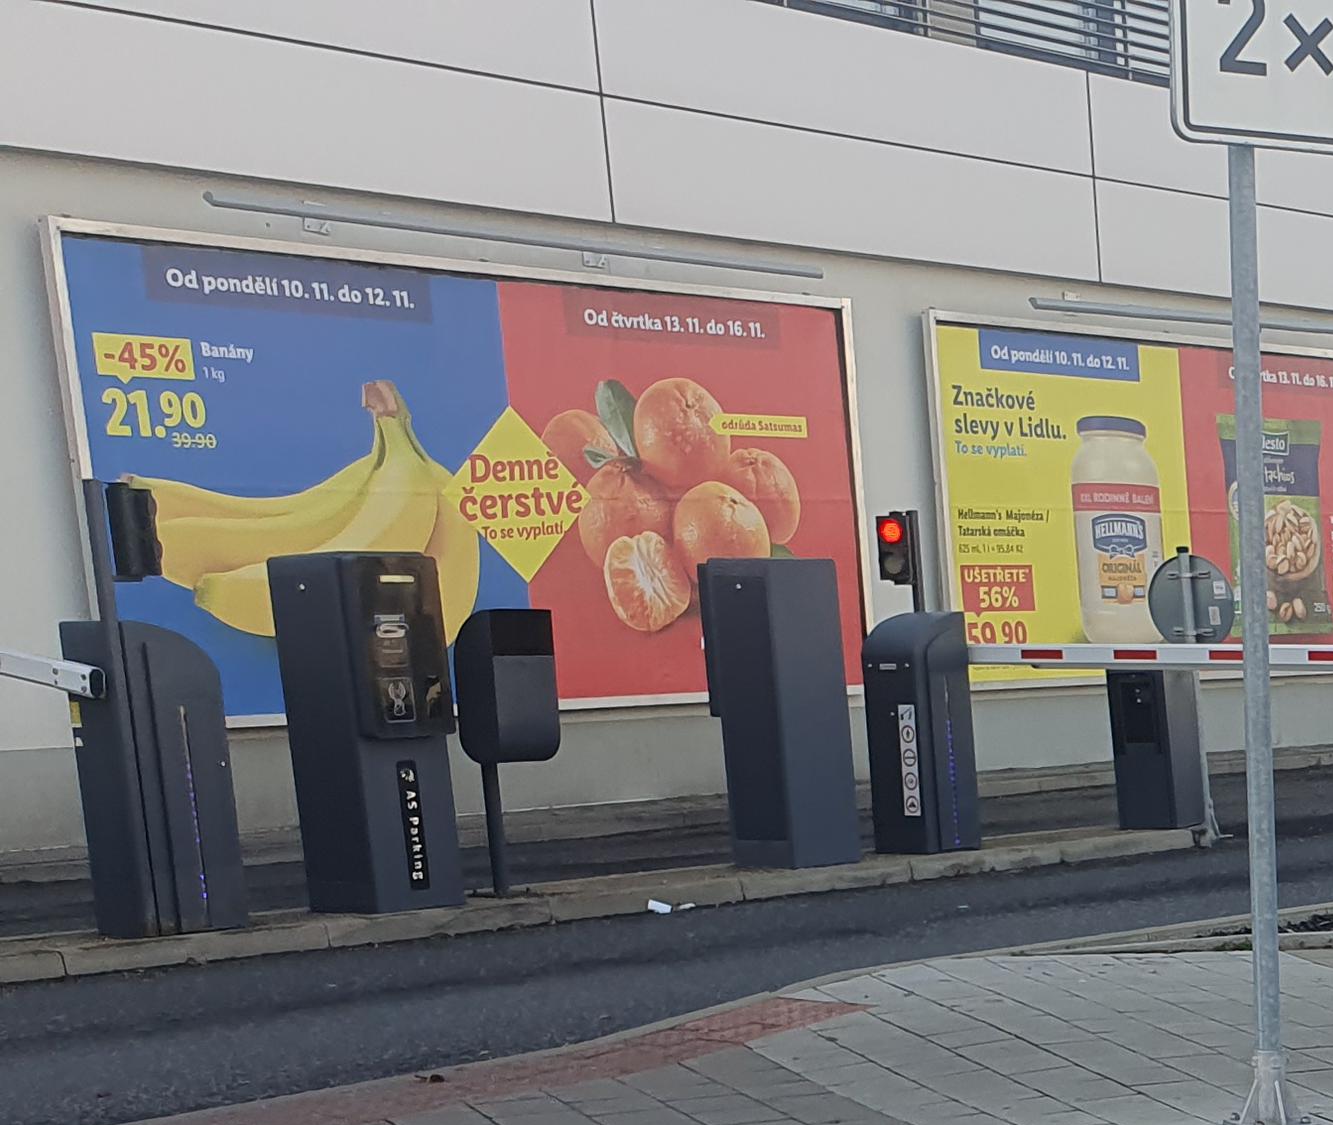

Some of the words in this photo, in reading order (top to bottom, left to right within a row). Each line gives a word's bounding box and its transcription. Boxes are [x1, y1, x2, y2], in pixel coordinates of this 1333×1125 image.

[165, 267, 199, 289] Od
[202, 274, 278, 296] pondělí
[281, 279, 309, 298] 10.
[312, 282, 335, 301] 11.
[338, 285, 361, 304] do
[365, 287, 390, 307] 12.
[392, 289, 415, 309] 11.
[583, 308, 608, 327] Od
[612, 311, 662, 332] čtvrtka
[665, 315, 684, 333] 13.
[686, 317, 704, 335] 11.
[706, 318, 725, 336] do
[727, 320, 746, 337] 16.
[748, 322, 766, 339] 11.
[102, 341, 187, 374] -45%
[200, 341, 254, 363] Banány
[990, 344, 1009, 360] Od
[1010, 349, 1053, 364] pondělí
[1055, 351, 1071, 366] 10.
[1072, 353, 1085, 367] 11.
[1086, 354, 1101, 368] do
[1101, 355, 1116, 369] 12.
[1117, 357, 1130, 370] 11.
[203, 366, 209, 379] 1
[211, 366, 225, 383] kg
[951, 384, 1035, 411] Značkové
[101, 387, 207, 439] 21.90
[721, 418, 757, 433] odrůda
[758, 419, 803, 434] Satsumas
[954, 413, 999, 440] slevy
[1004, 421, 1014, 436] v
[1019, 416, 1067, 440] Lidlu.
[955, 440, 968, 454] To
[971, 444, 983, 455] se
[1262, 435, 1285, 450] lesto
[468, 450, 560, 484] Denně
[458, 481, 583, 523] čerstvé
[481, 526, 497, 540] To
[500, 527, 514, 539] se
[978, 586, 1019, 608] 56%
[967, 621, 1028, 644] 5990
[406, 790, 418, 810] AS
[409, 816, 424, 880] Parking
